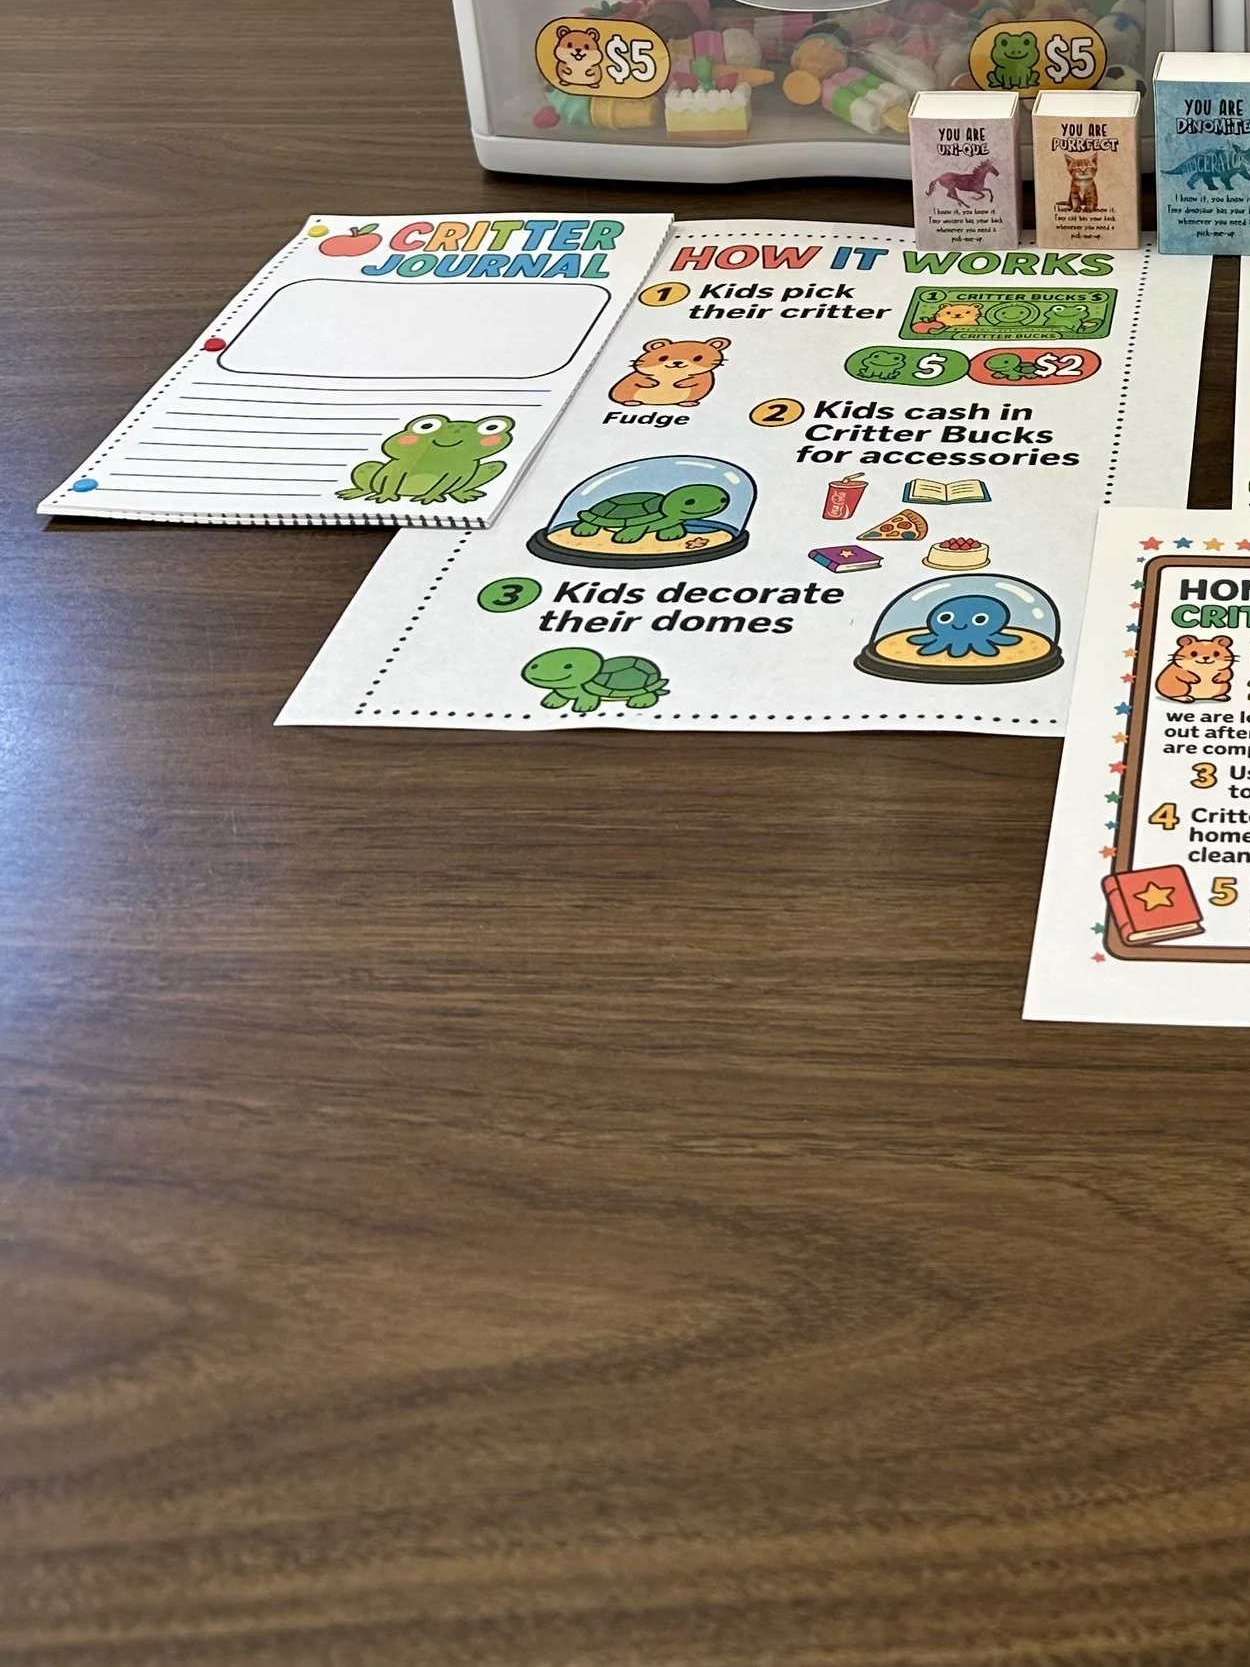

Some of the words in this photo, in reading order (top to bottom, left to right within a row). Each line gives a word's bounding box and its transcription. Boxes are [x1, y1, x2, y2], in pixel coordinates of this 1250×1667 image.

[606, 36, 655, 84] $5
[1045, 35, 1096, 82] $5
[1185, 100, 1211, 115] YOU
[1219, 100, 1243, 116] ARE
[939, 128, 960, 141] YOU
[966, 128, 985, 141] ARE
[1062, 124, 1082, 136] YOU
[1089, 124, 1107, 137] ARE
[1052, 138, 1119, 152] PURRFECT
[389, 220, 624, 252] CRITTER
[361, 253, 611, 279] JOURNAL
[670, 245, 823, 272] HOW
[829, 248, 889, 272] IT
[902, 251, 1115, 277] WORKS
[655, 288, 672, 302] 1
[699, 283, 775, 301] Kids
[780, 283, 855, 304] pick
[927, 291, 941, 302] 1
[956, 291, 1026, 302] CRITTER
[1030, 291, 1086, 302] BUCKS
[689, 303, 773, 320] their
[780, 303, 891, 320] critter
[1034, 352, 1083, 379] $2
[603, 410, 690, 427] Fudge
[768, 404, 787, 421] 2
[812, 400, 895, 421] Kids
[903, 403, 992, 421] cash
[1000, 403, 1033, 421] in
[804, 425, 934, 444] Critter
[939, 425, 1054, 444] Bucks
[796, 446, 853, 467] for
[859, 447, 1080, 467] accessories
[491, 584, 523, 606] 3
[552, 581, 647, 606] Kids
[656, 581, 845, 606] decorate
[538, 610, 642, 633] their
[650, 610, 795, 635] domes
[1190, 762, 1218, 789] 3
[1148, 802, 1180, 830] 4
[1209, 878, 1238, 906] 5
